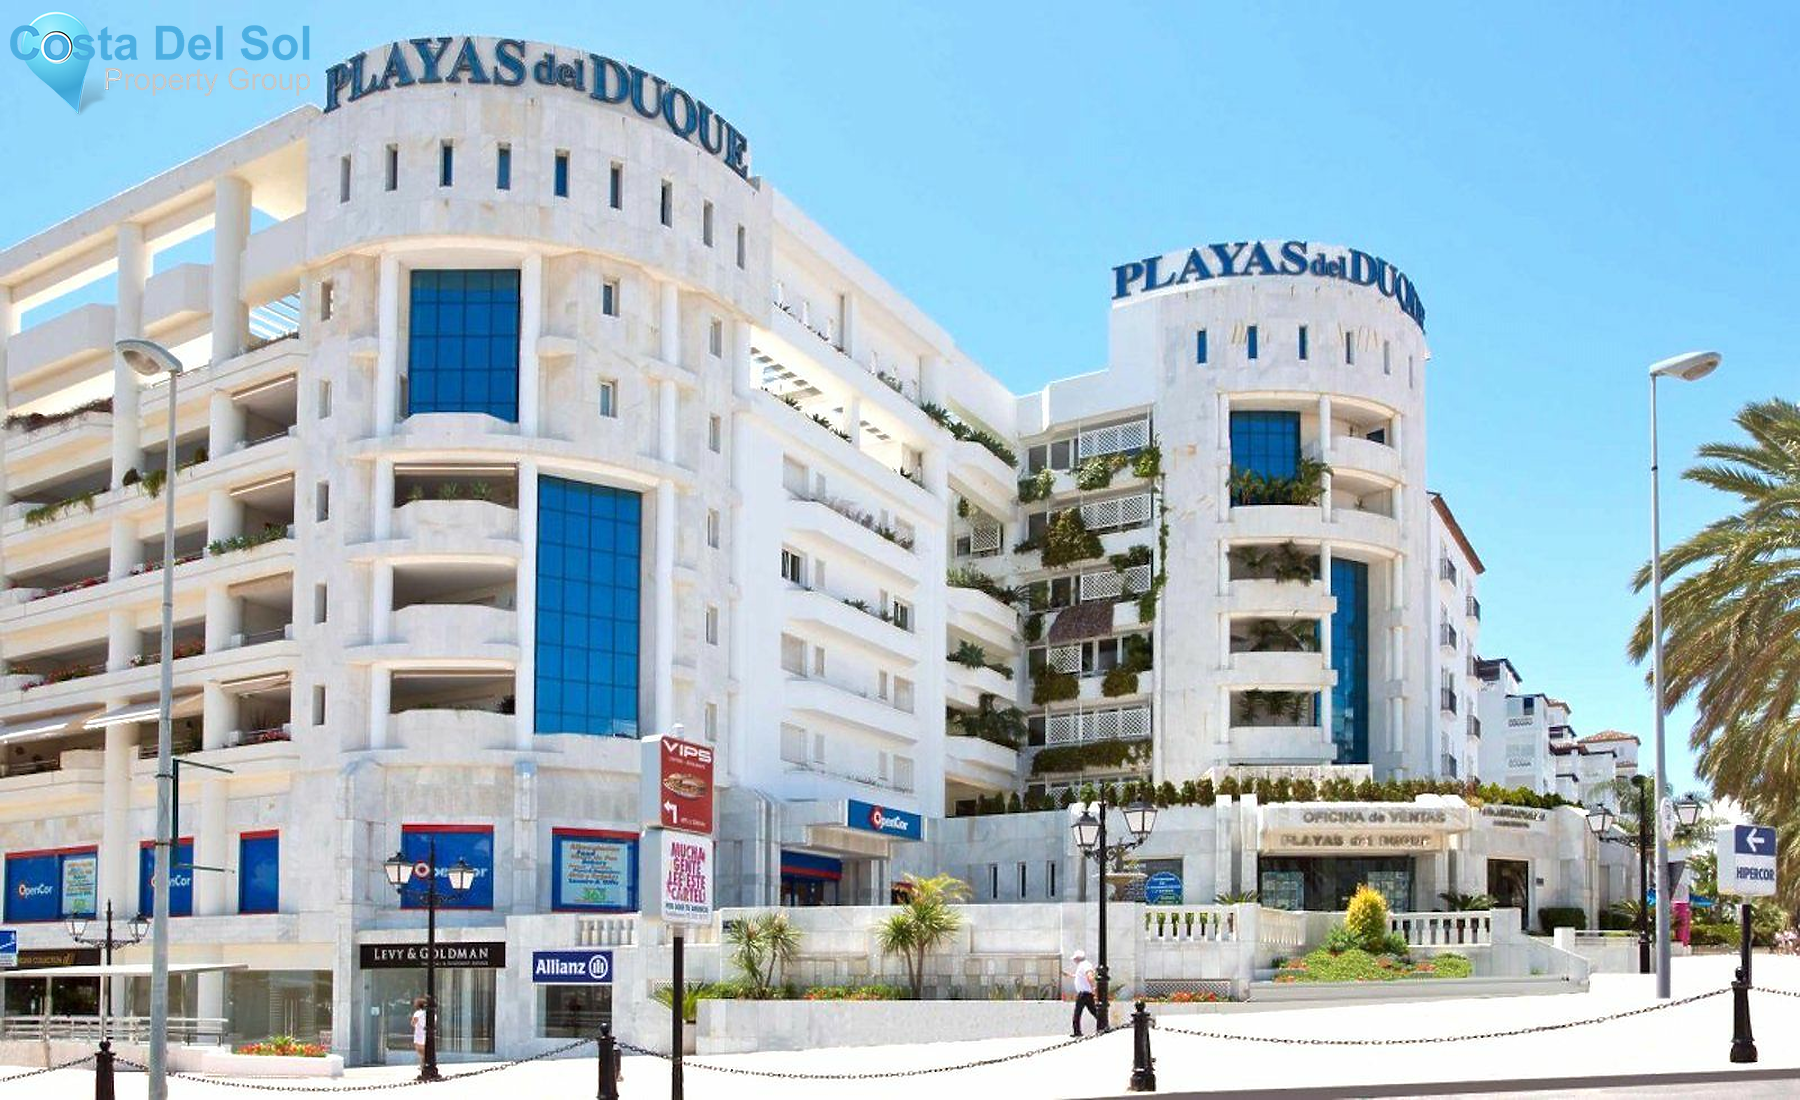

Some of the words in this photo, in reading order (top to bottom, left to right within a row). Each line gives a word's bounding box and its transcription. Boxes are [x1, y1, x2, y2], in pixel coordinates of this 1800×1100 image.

[323, 35, 526, 114] PLAYAS
[533, 52, 585, 91] del
[589, 52, 748, 180] DUQUE
[1111, 240, 1308, 301] PLAYAS
[1309, 251, 1346, 279] del
[662, 739, 712, 764] VIPS
[1302, 810, 1365, 824] OFICINA
[1368, 811, 1385, 824] de
[1390, 810, 1447, 824] VENTAS
[671, 842, 706, 862] MUCHA
[673, 859, 702, 876] GENTE
[1736, 865, 1775, 881] HIPERCOR
[686, 873, 706, 890] ESTE
[18, 882, 54, 899] OpenCor
[374, 948, 404, 960] LEVY
[407, 947, 417, 959] &
[535, 958, 586, 975] Allianz
